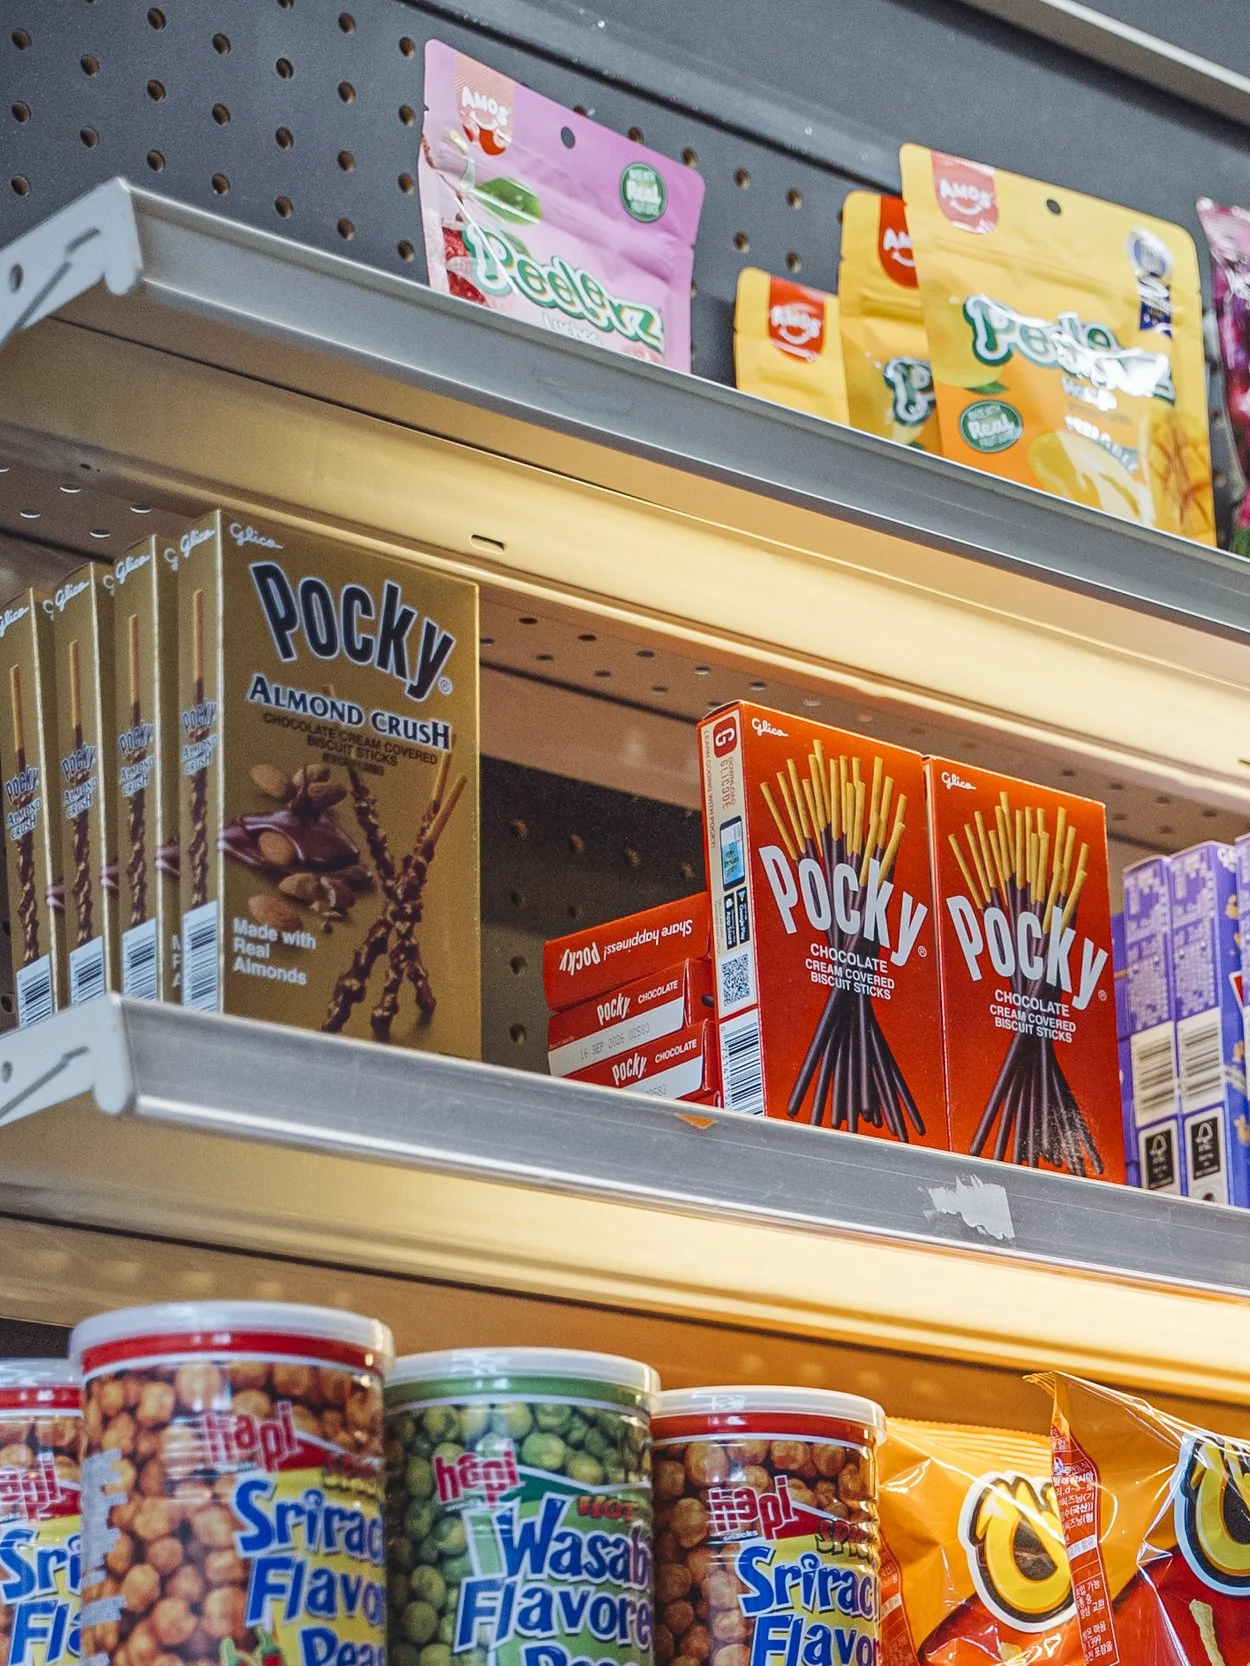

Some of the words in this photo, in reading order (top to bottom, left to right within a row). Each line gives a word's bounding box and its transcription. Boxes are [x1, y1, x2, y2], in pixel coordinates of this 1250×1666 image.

[461, 85, 512, 128] AMOS
[938, 176, 993, 210] AMOS
[769, 302, 822, 340] AMOS
[180, 528, 216, 558] Glico
[229, 522, 284, 549] Glico
[115, 554, 151, 585] Glico
[55, 580, 90, 611] Glico
[250, 560, 456, 702] Pocky
[183, 699, 217, 738] Pocky
[249, 672, 365, 728] ALMOND
[370, 710, 452, 752] CRUSH
[751, 717, 788, 739] Glico
[119, 720, 155, 755] Pocky
[182, 732, 218, 764] ALMOND
[262, 711, 339, 742] CHOCOLATE
[338, 731, 383, 752] CREAM
[384, 741, 438, 766] COVERED
[62, 744, 96, 781] Pocky
[120, 755, 155, 784] ALMOND
[182, 751, 212, 776] CRUSH
[357, 748, 399, 768] STICKS
[5, 766, 39, 799] Pocky
[64, 776, 98, 805] ALMOND
[121, 773, 149, 797] CRUSH
[705, 759, 713, 792] CODING
[941, 771, 977, 790] Glico
[7, 798, 42, 828] ALMOND
[66, 794, 93, 820] CRUSH
[9, 815, 38, 841] CRUSH
[759, 845, 928, 967] Pocky
[232, 917, 278, 942] Made
[281, 930, 317, 950] with
[661, 919, 693, 938] Share
[232, 939, 271, 958] Real
[559, 942, 601, 976] Pocky
[603, 929, 660, 961] happiness!
[810, 943, 888, 974] CHOCOLATE
[946, 894, 1108, 1011] Pocky
[233, 955, 308, 986] Almonds
[805, 958, 843, 980] CREAM
[845, 967, 895, 990] COVERED
[811, 972, 851, 992] BISCUIT
[853, 980, 891, 1000] STICKS
[596, 992, 631, 1026] Pocky
[637, 980, 679, 1004] CHOCOLATE
[989, 1004, 1026, 1022] CREAM
[1028, 1013, 1077, 1033] COVERED
[994, 989, 1070, 1018] CHOCOLATE
[994, 1017, 1034, 1036] BISCUIT
[1036, 1026, 1073, 1044] STICKS
[611, 1052, 648, 1087] Pocky
[655, 1038, 697, 1063] CHOCOLATE
[434, 1437, 524, 1511] hapi
[234, 1476, 385, 1566] Srirac
[576, 1494, 637, 1523] HOT
[708, 1474, 792, 1541] hapi
[496, 1491, 652, 1589] Wasab
[722, 1529, 759, 1542] snacks
[246, 1554, 385, 1630] Flavo
[736, 1542, 880, 1621] Srirac
[454, 1575, 653, 1653] Flavore
